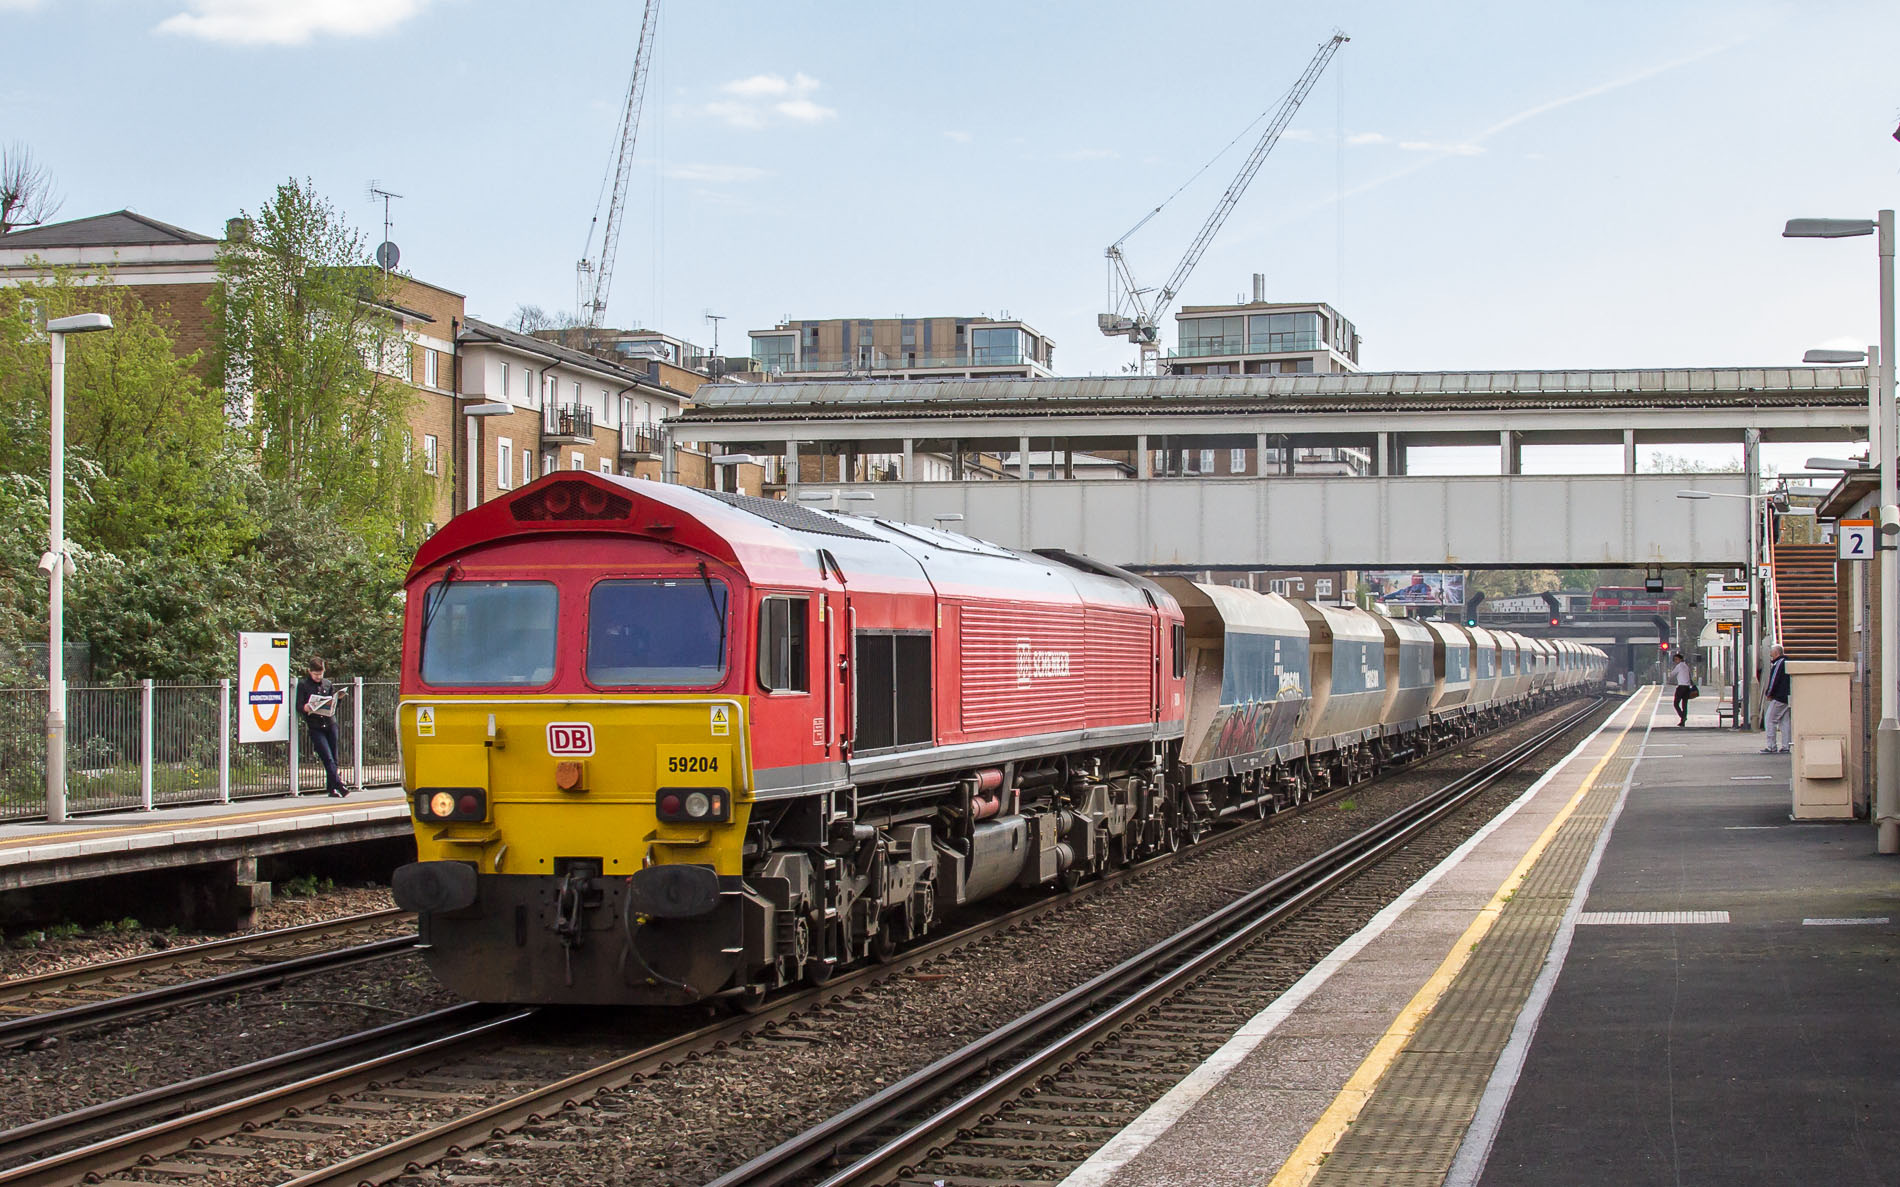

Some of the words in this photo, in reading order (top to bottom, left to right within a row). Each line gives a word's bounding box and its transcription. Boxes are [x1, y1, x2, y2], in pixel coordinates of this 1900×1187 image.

[1850, 533, 1864, 554] 2
[1762, 568, 1768, 576] 2
[555, 730, 586, 748] DB
[669, 757, 718, 772] 59204
